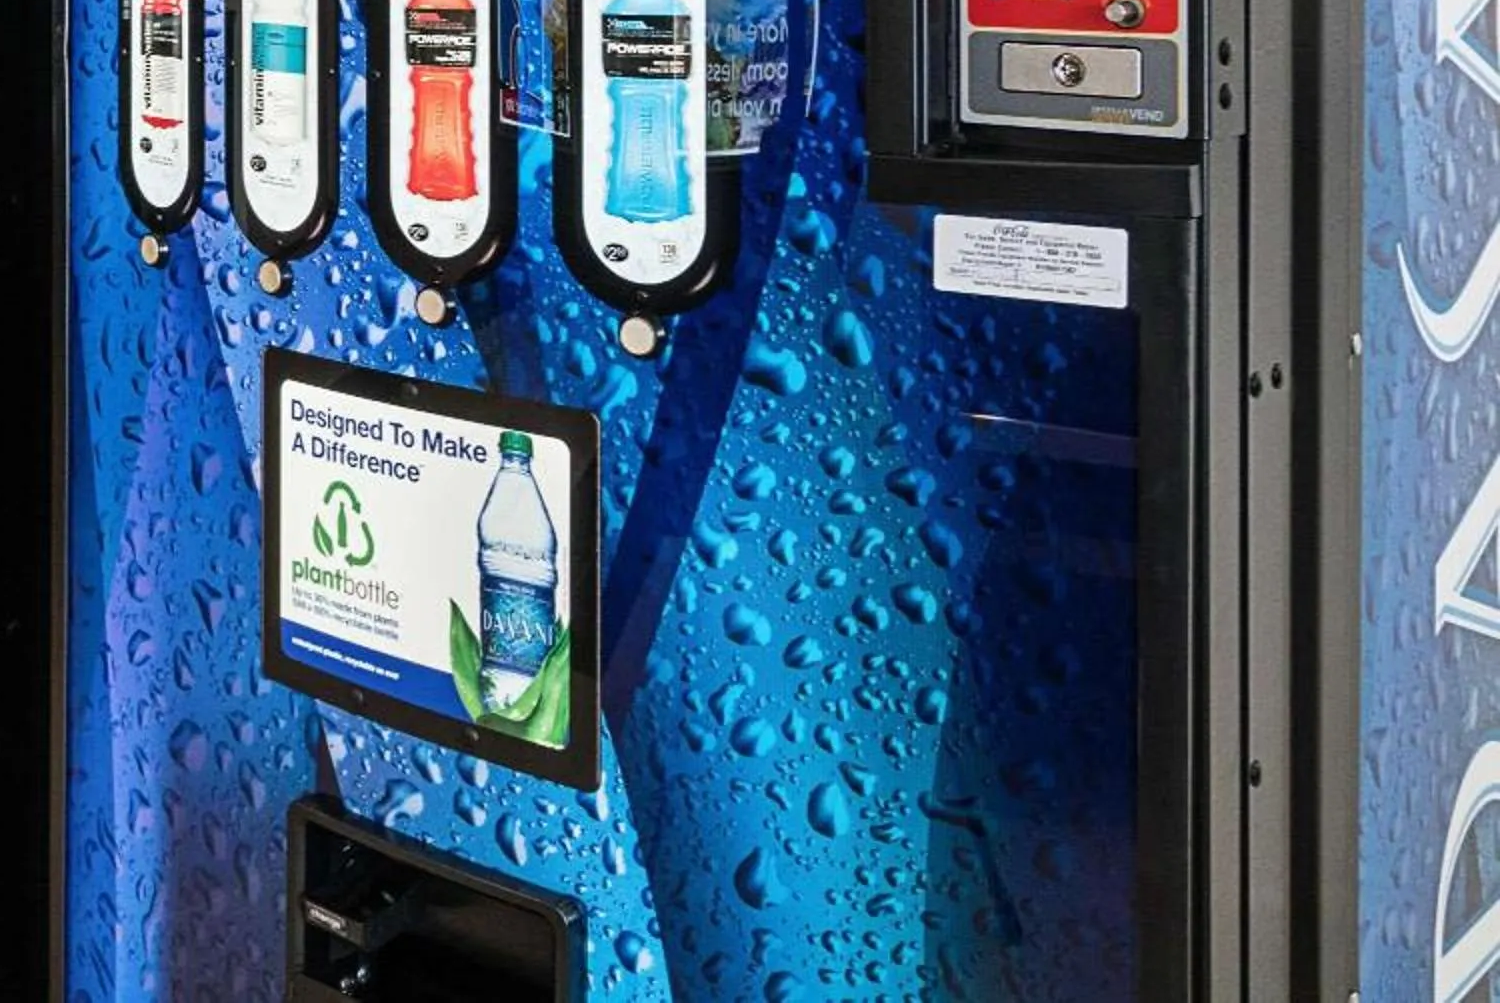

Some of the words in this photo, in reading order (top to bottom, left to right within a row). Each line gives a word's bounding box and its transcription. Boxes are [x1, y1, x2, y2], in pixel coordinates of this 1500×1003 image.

[607, 43, 687, 55] POWERADE
[291, 399, 383, 441] Designed
[389, 421, 415, 448] To
[422, 428, 488, 464] Make
[291, 432, 306, 455] A
[311, 435, 420, 483] Difference
[292, 557, 399, 610] plantbottle
